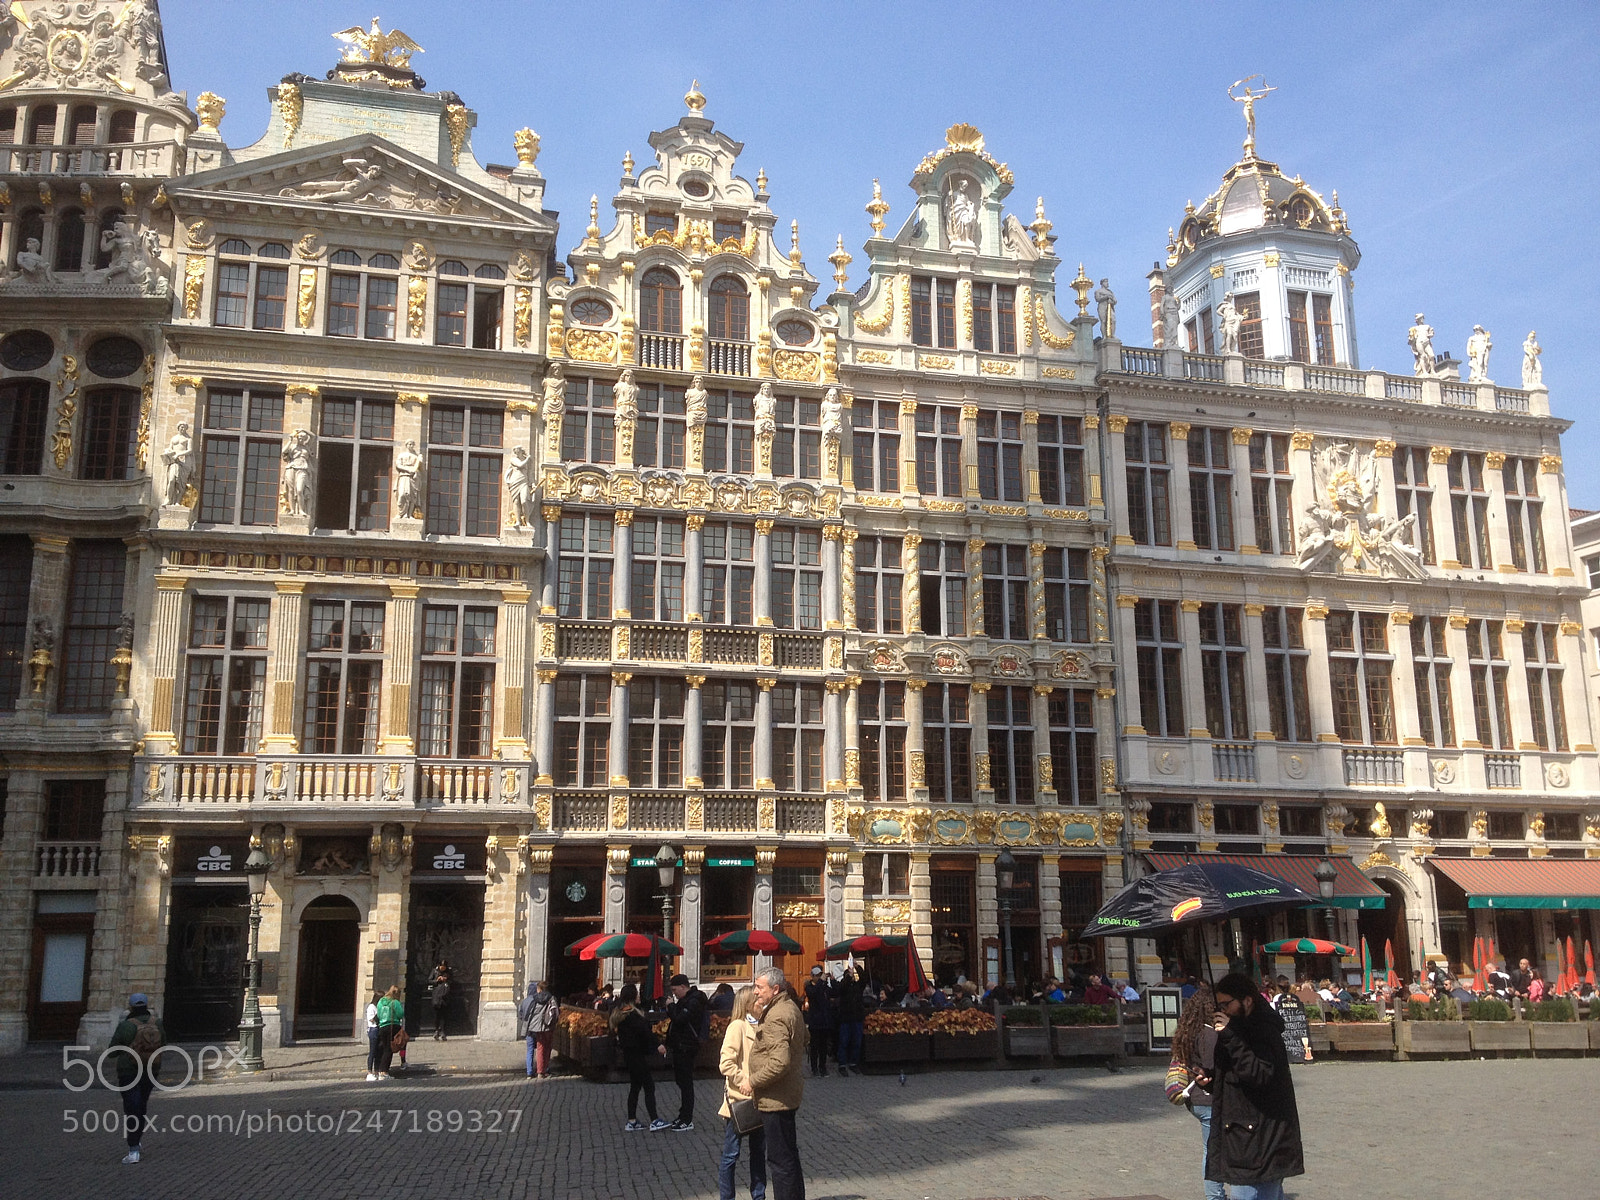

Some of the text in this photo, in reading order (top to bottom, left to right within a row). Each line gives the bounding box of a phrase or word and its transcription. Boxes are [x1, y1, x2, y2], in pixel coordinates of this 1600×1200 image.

[682, 153, 711, 168] 1697
[197, 861, 231, 871] CBC
[433, 860, 465, 870] CBC
[1122, 918, 1141, 927] TOURS
